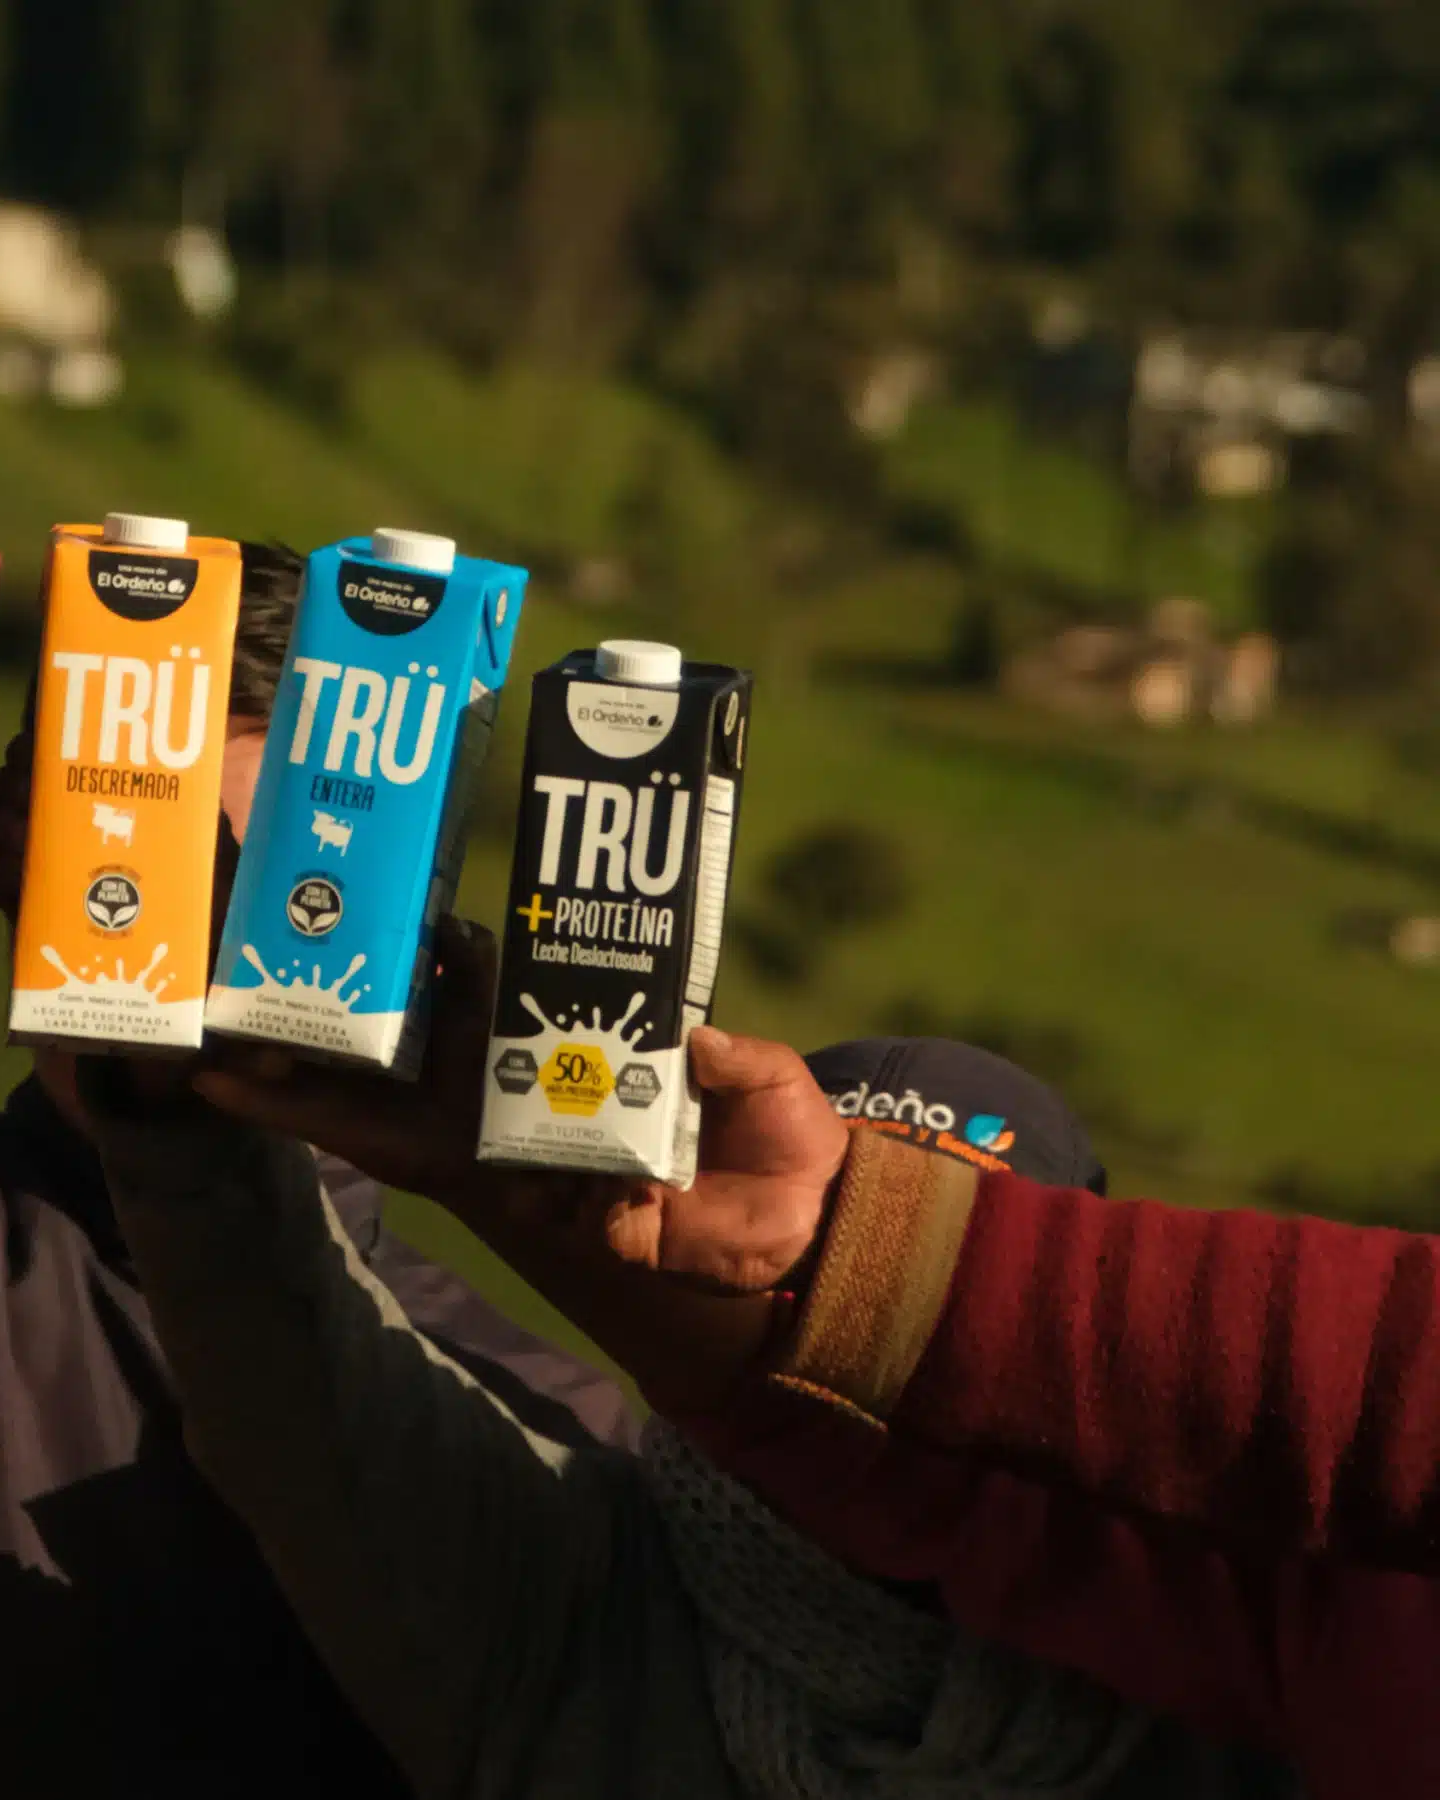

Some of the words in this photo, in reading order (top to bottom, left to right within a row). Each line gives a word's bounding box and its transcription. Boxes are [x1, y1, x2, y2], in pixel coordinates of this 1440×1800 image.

[98, 572, 111, 587] El
[112, 574, 166, 591] Ordeño
[344, 583, 359, 598] El
[360, 586, 410, 608] Ordeño
[52, 645, 211, 769] TRÜ
[288, 656, 446, 785] TRÜ
[578, 707, 590, 720] El
[592, 709, 644, 726] Ordeño
[67, 765, 180, 801] DESCREMADA
[311, 775, 375, 812] ENTERA
[534, 769, 691, 897] TRÜ
[554, 897, 674, 947] PROTEÍNA
[532, 938, 569, 963] Leche
[570, 942, 654, 973] Deslactosada
[552, 1052, 602, 1086] 50%
[828, 1082, 956, 1131] deño
